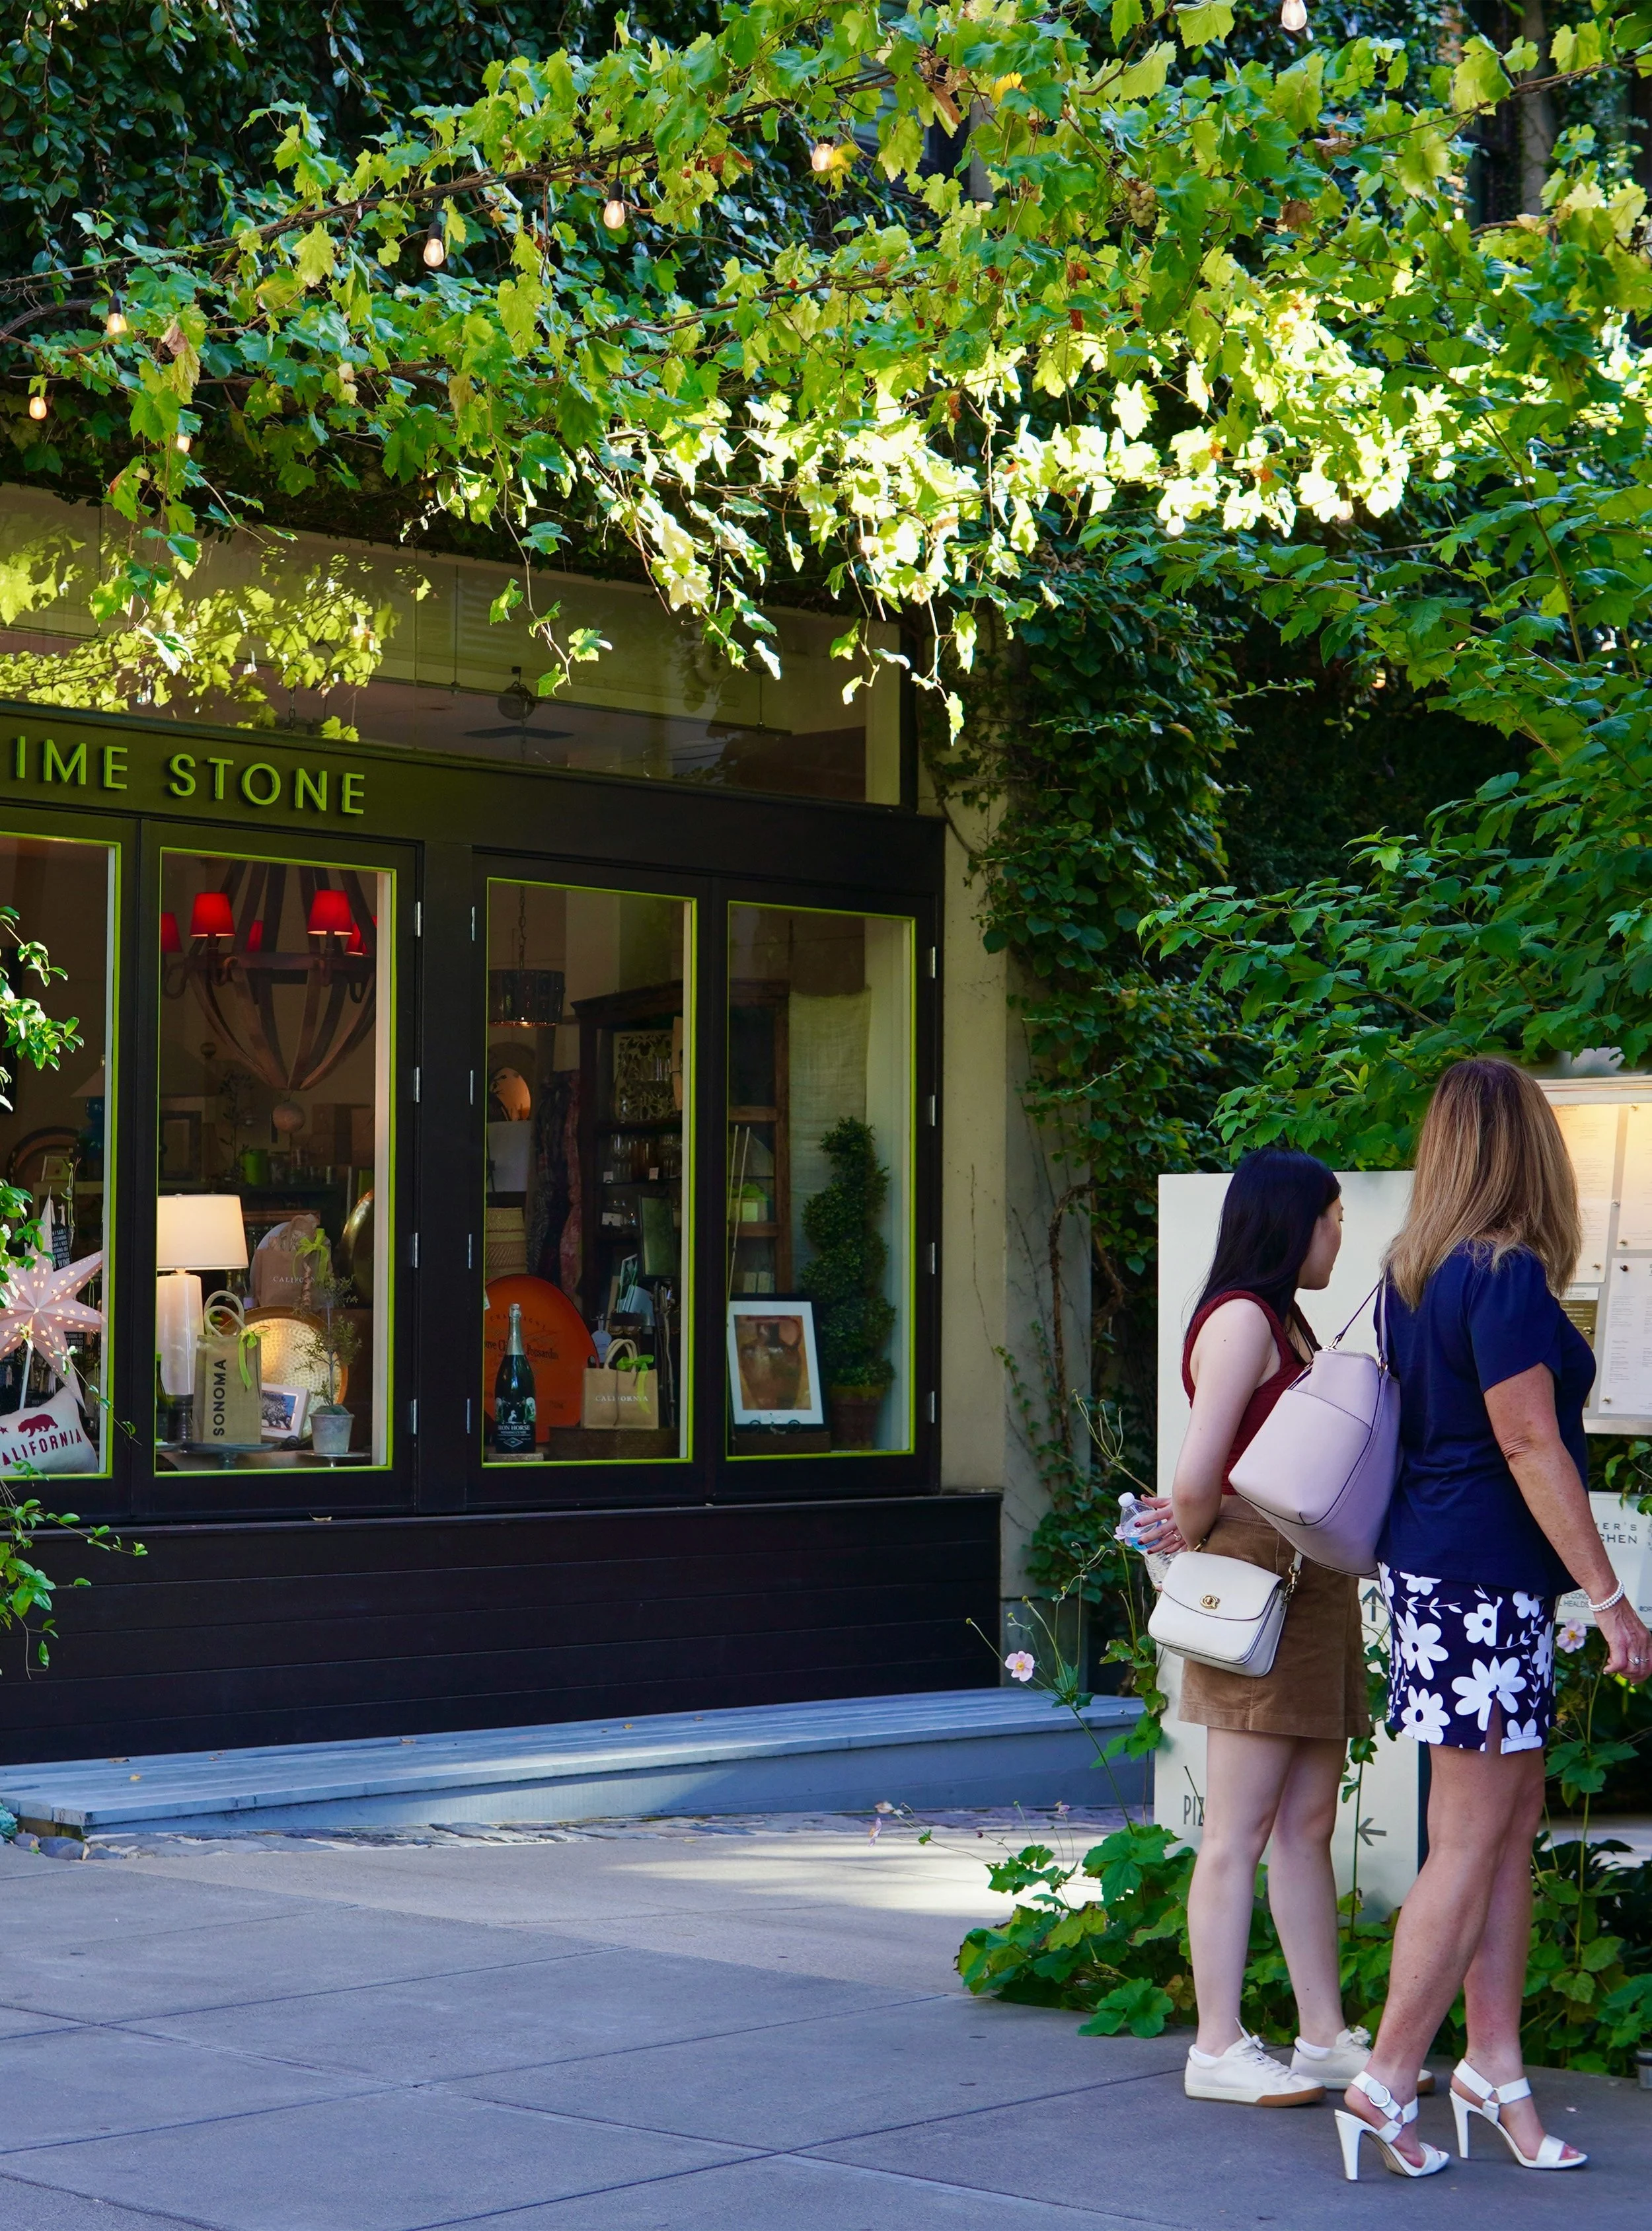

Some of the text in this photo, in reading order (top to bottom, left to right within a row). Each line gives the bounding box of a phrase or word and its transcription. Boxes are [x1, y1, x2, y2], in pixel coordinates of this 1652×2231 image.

[169, 753, 365, 814] STONE
[213, 1359, 226, 1437] SONOMA
[1595, 1522, 1637, 1531] ER'S
